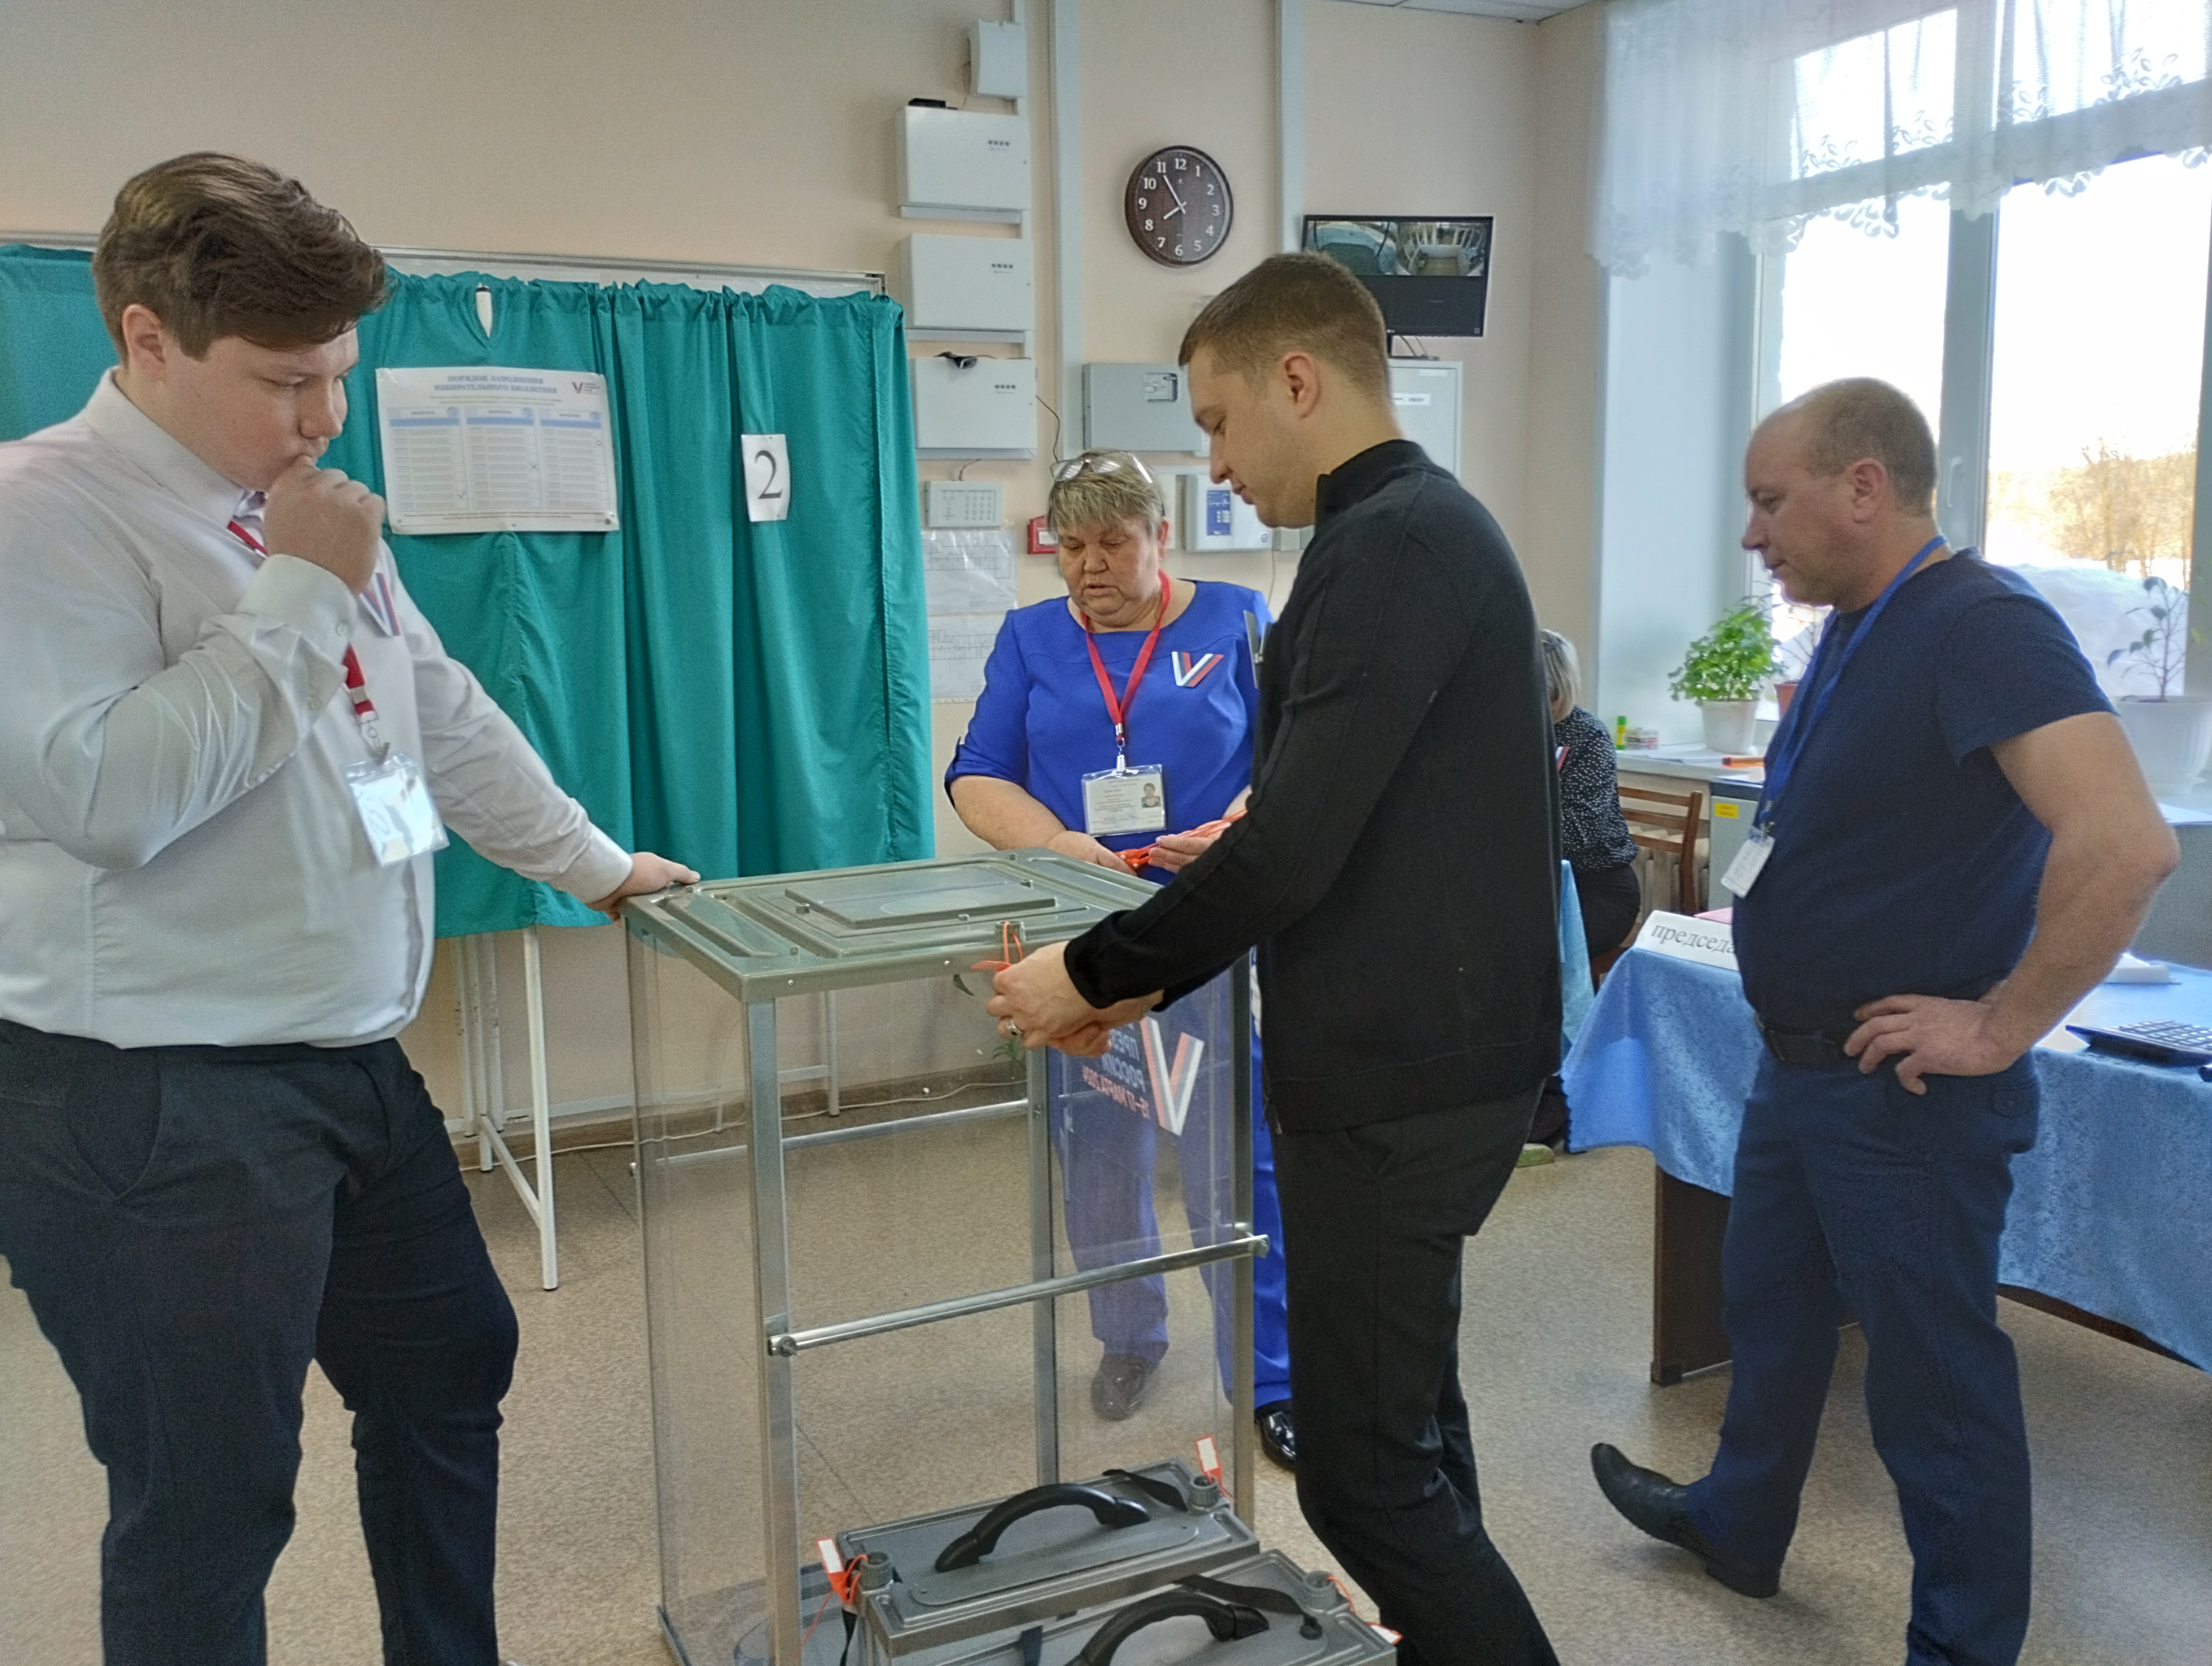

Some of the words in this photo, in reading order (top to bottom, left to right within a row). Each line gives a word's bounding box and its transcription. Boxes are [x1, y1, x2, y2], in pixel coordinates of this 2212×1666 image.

[1157, 162, 1166, 173] 11
[1175, 158, 1187, 170] 12
[1195, 165, 1200, 177] 1
[1143, 177, 1156, 189] 10
[1206, 184, 1214, 196] 2
[1139, 197, 1147, 209] 9
[1211, 204, 1219, 216] 3
[1144, 219, 1154, 231] 8
[1206, 225, 1214, 236] 4
[1157, 237, 1166, 248] 7
[1194, 240, 1202, 251] 5
[1175, 245, 1184, 256] 6
[755, 450, 782, 499] 2
[1651, 925, 1734, 953] председа
